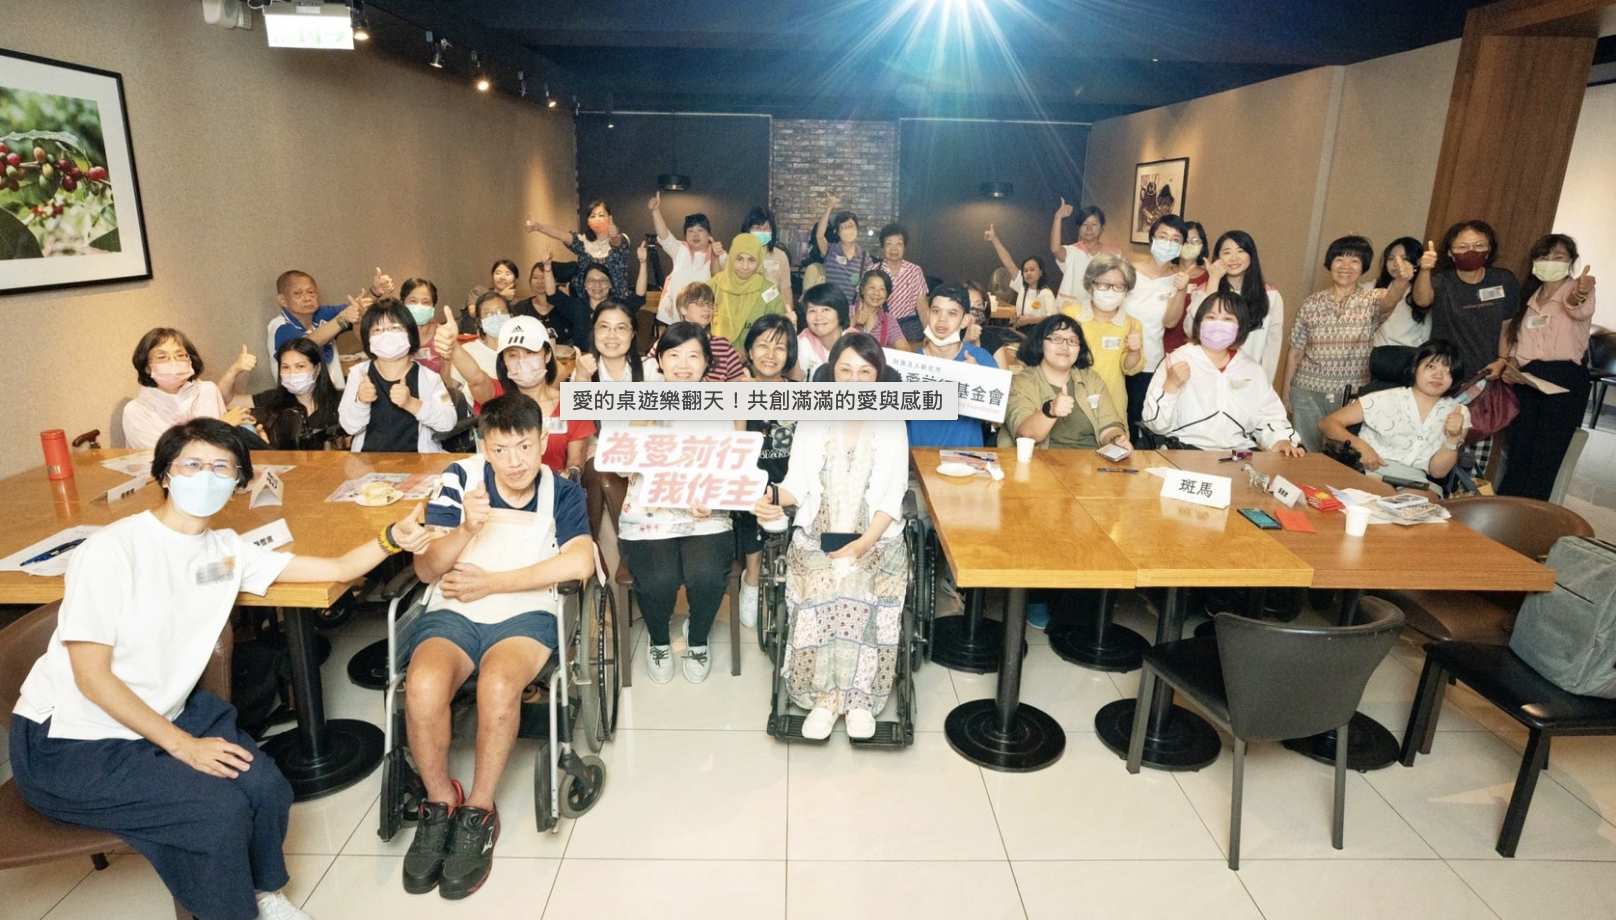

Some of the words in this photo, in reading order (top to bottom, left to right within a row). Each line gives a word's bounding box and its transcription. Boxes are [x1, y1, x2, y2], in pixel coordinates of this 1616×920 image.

[602, 431, 757, 470] 為愛前行
[648, 472, 759, 506] 我作主
[1178, 479, 1213, 498] 斑馬
